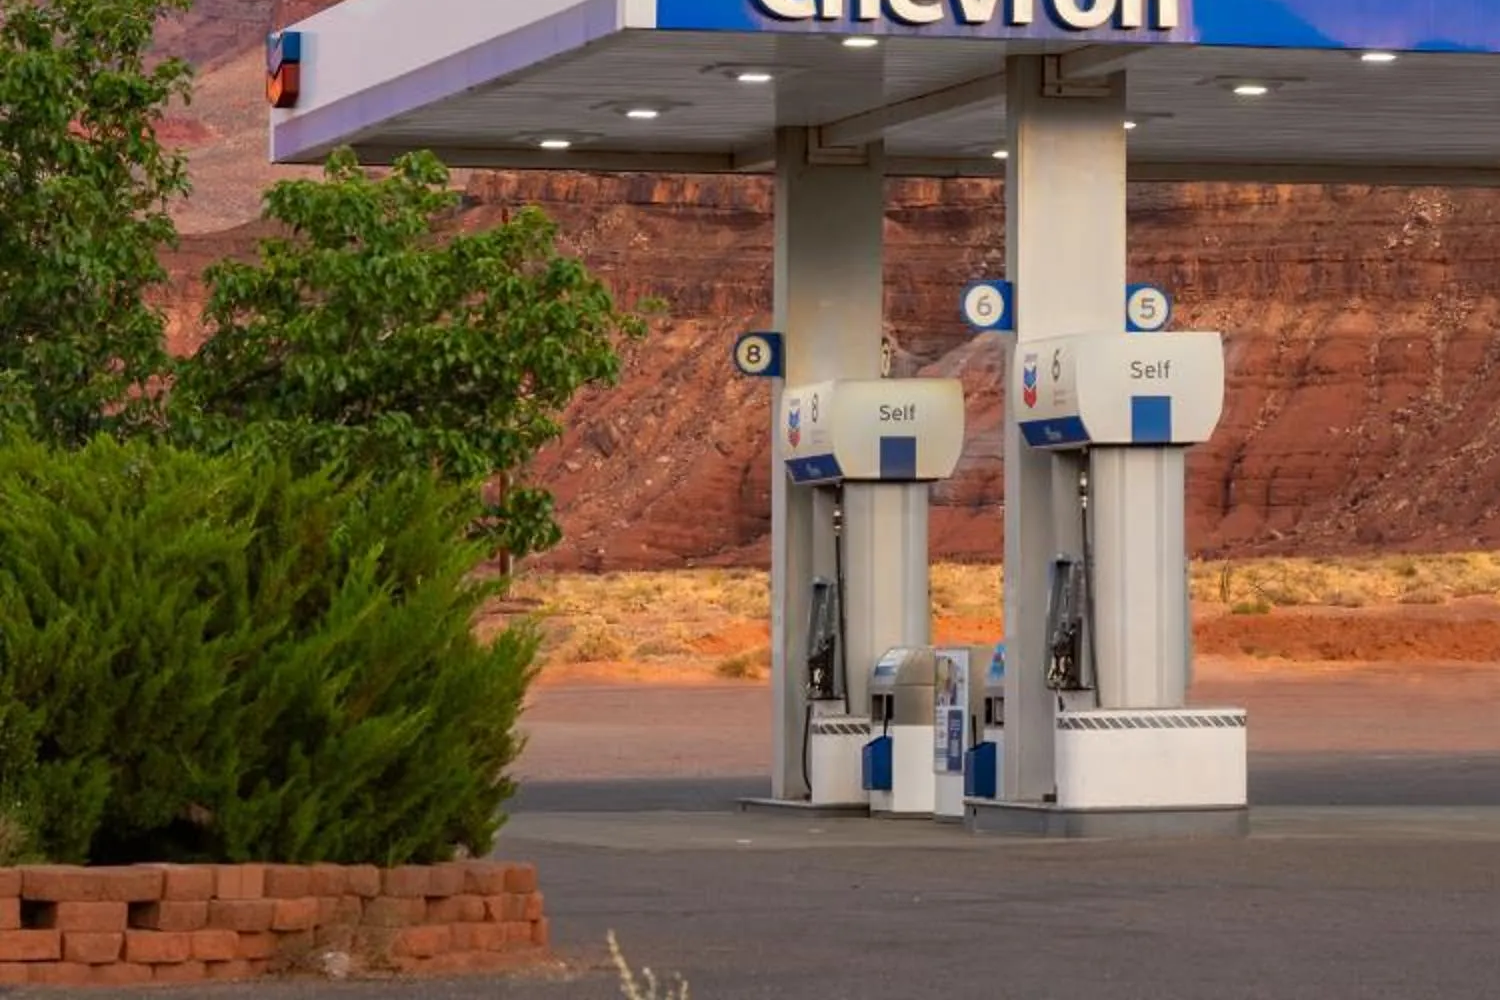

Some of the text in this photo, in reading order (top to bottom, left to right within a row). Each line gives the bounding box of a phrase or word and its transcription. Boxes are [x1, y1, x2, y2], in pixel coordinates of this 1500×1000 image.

[977, 295, 993, 317] 6
[1139, 297, 1156, 320] 5
[746, 344, 762, 365] 8
[1051, 348, 1061, 383] 6
[1129, 360, 1172, 379] Self
[879, 403, 916, 421] Self
